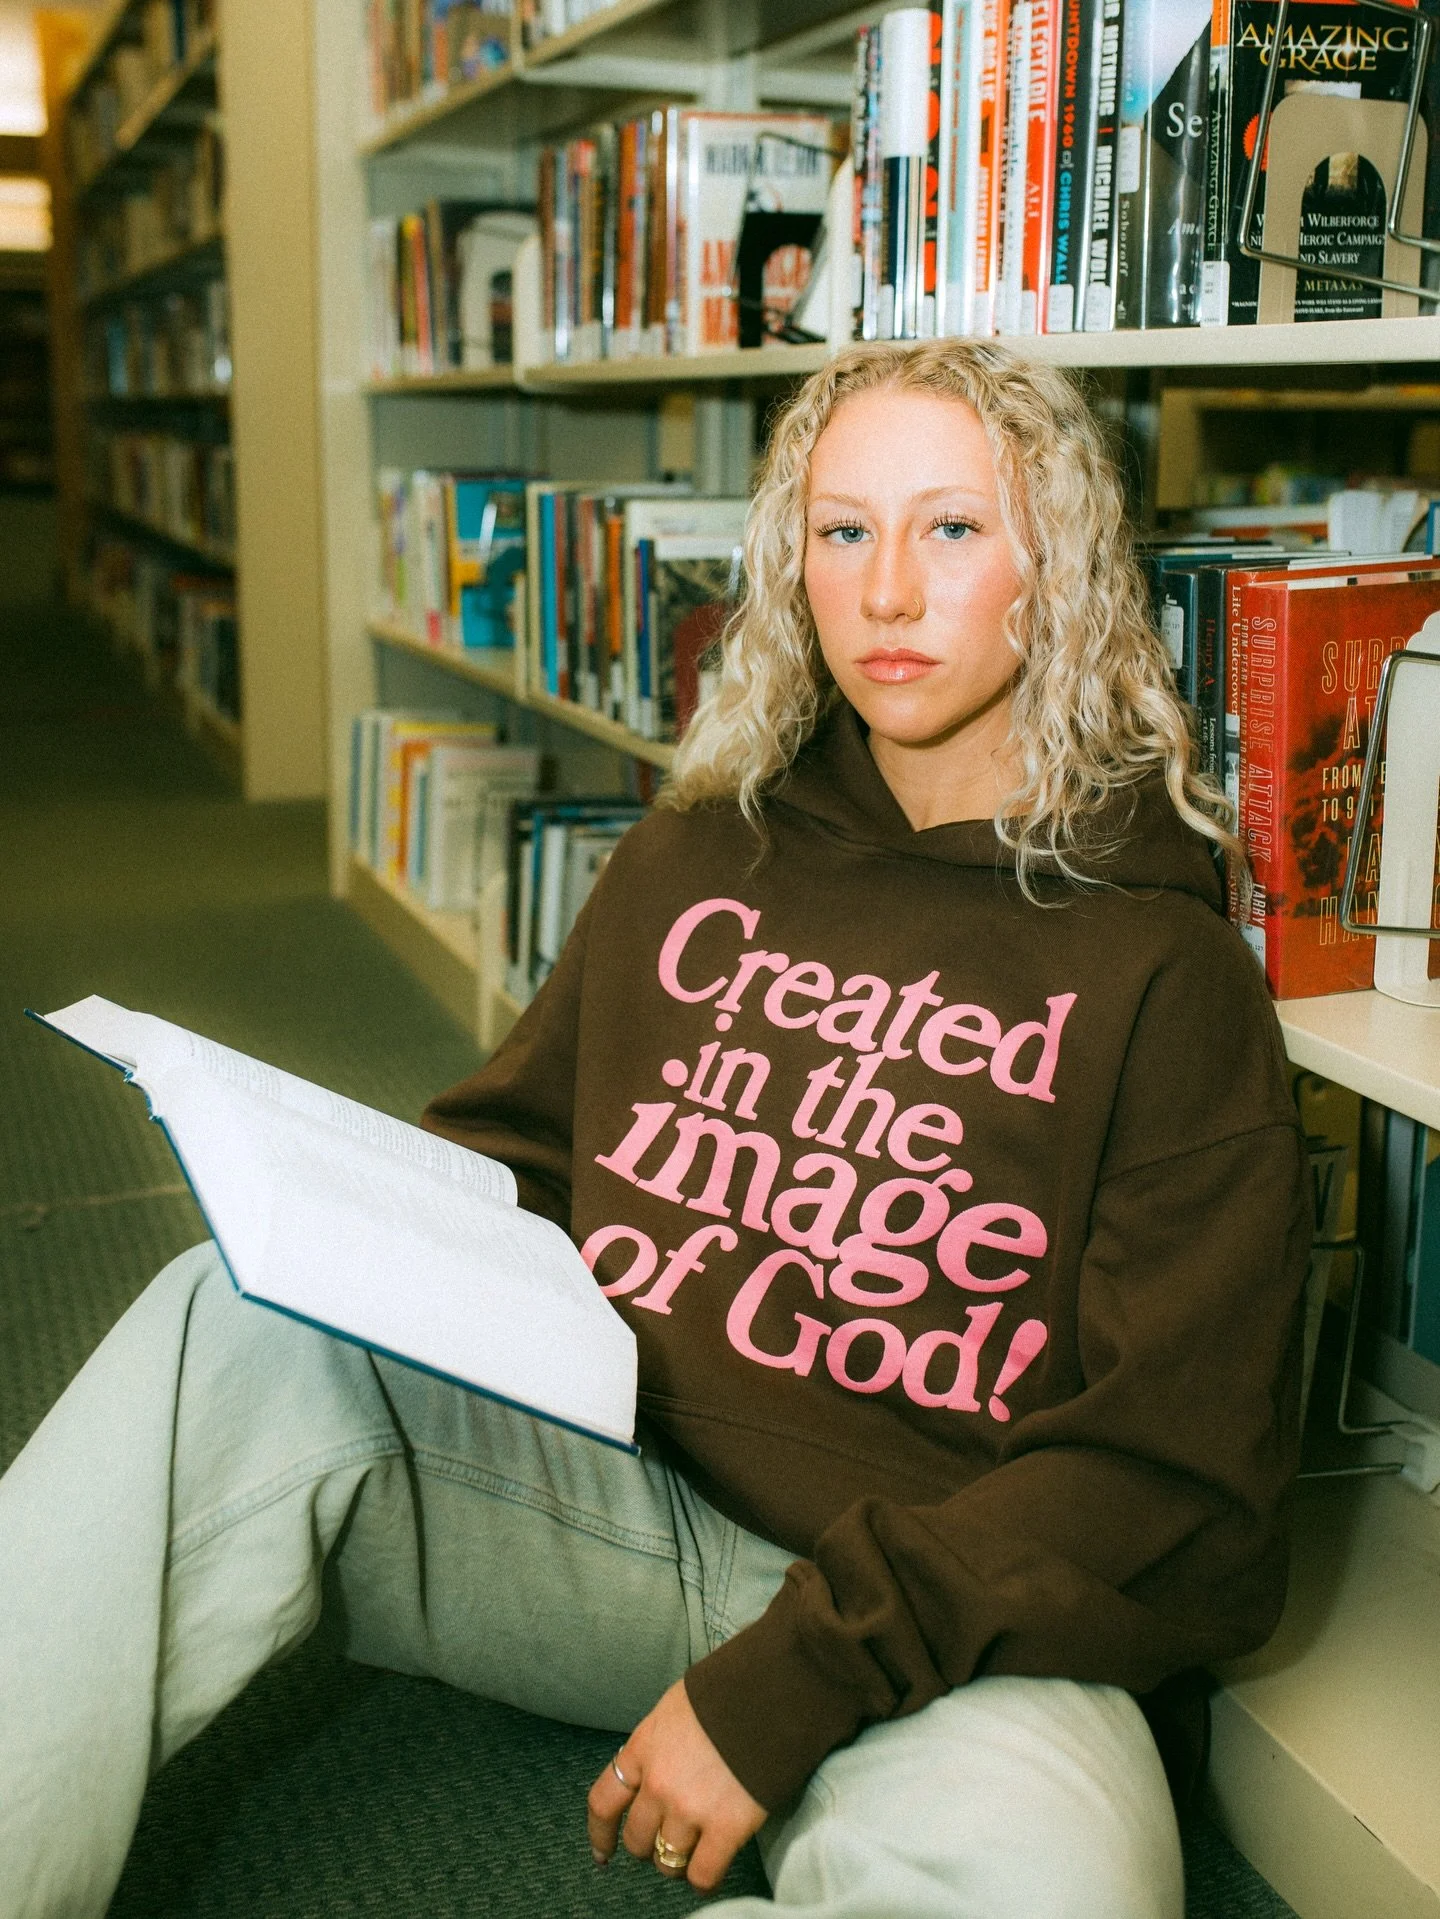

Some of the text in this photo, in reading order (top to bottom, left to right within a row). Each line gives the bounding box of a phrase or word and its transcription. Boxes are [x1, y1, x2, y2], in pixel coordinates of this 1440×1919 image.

[1099, 24, 1119, 116] NOTHING
[1236, 22, 1410, 52] AMAZING
[1259, 47, 1378, 75] GRACE
[1062, 103, 1076, 148] 1960
[1058, 171, 1073, 229] CHRIS
[1092, 145, 1113, 233] MICHAEL
[1119, 200, 1130, 277] Soboroff
[1207, 195, 1220, 251] GRACE
[1231, 585, 1241, 717] Life Undercover
[1240, 618, 1249, 649] FROM
[1250, 616, 1277, 752] SURPRISE
[1209, 717, 1217, 748] Lessons
[1321, 798, 1339, 823] TO
[1322, 764, 1362, 791] FROM
[1248, 763, 1273, 863] ATTACK
[1252, 882, 1266, 926] LARRY
[658, 897, 1078, 1103] Created
[684, 1013, 964, 1172] in the
[594, 1059, 1049, 1307] image
[580, 1224, 1049, 1422] of God!
